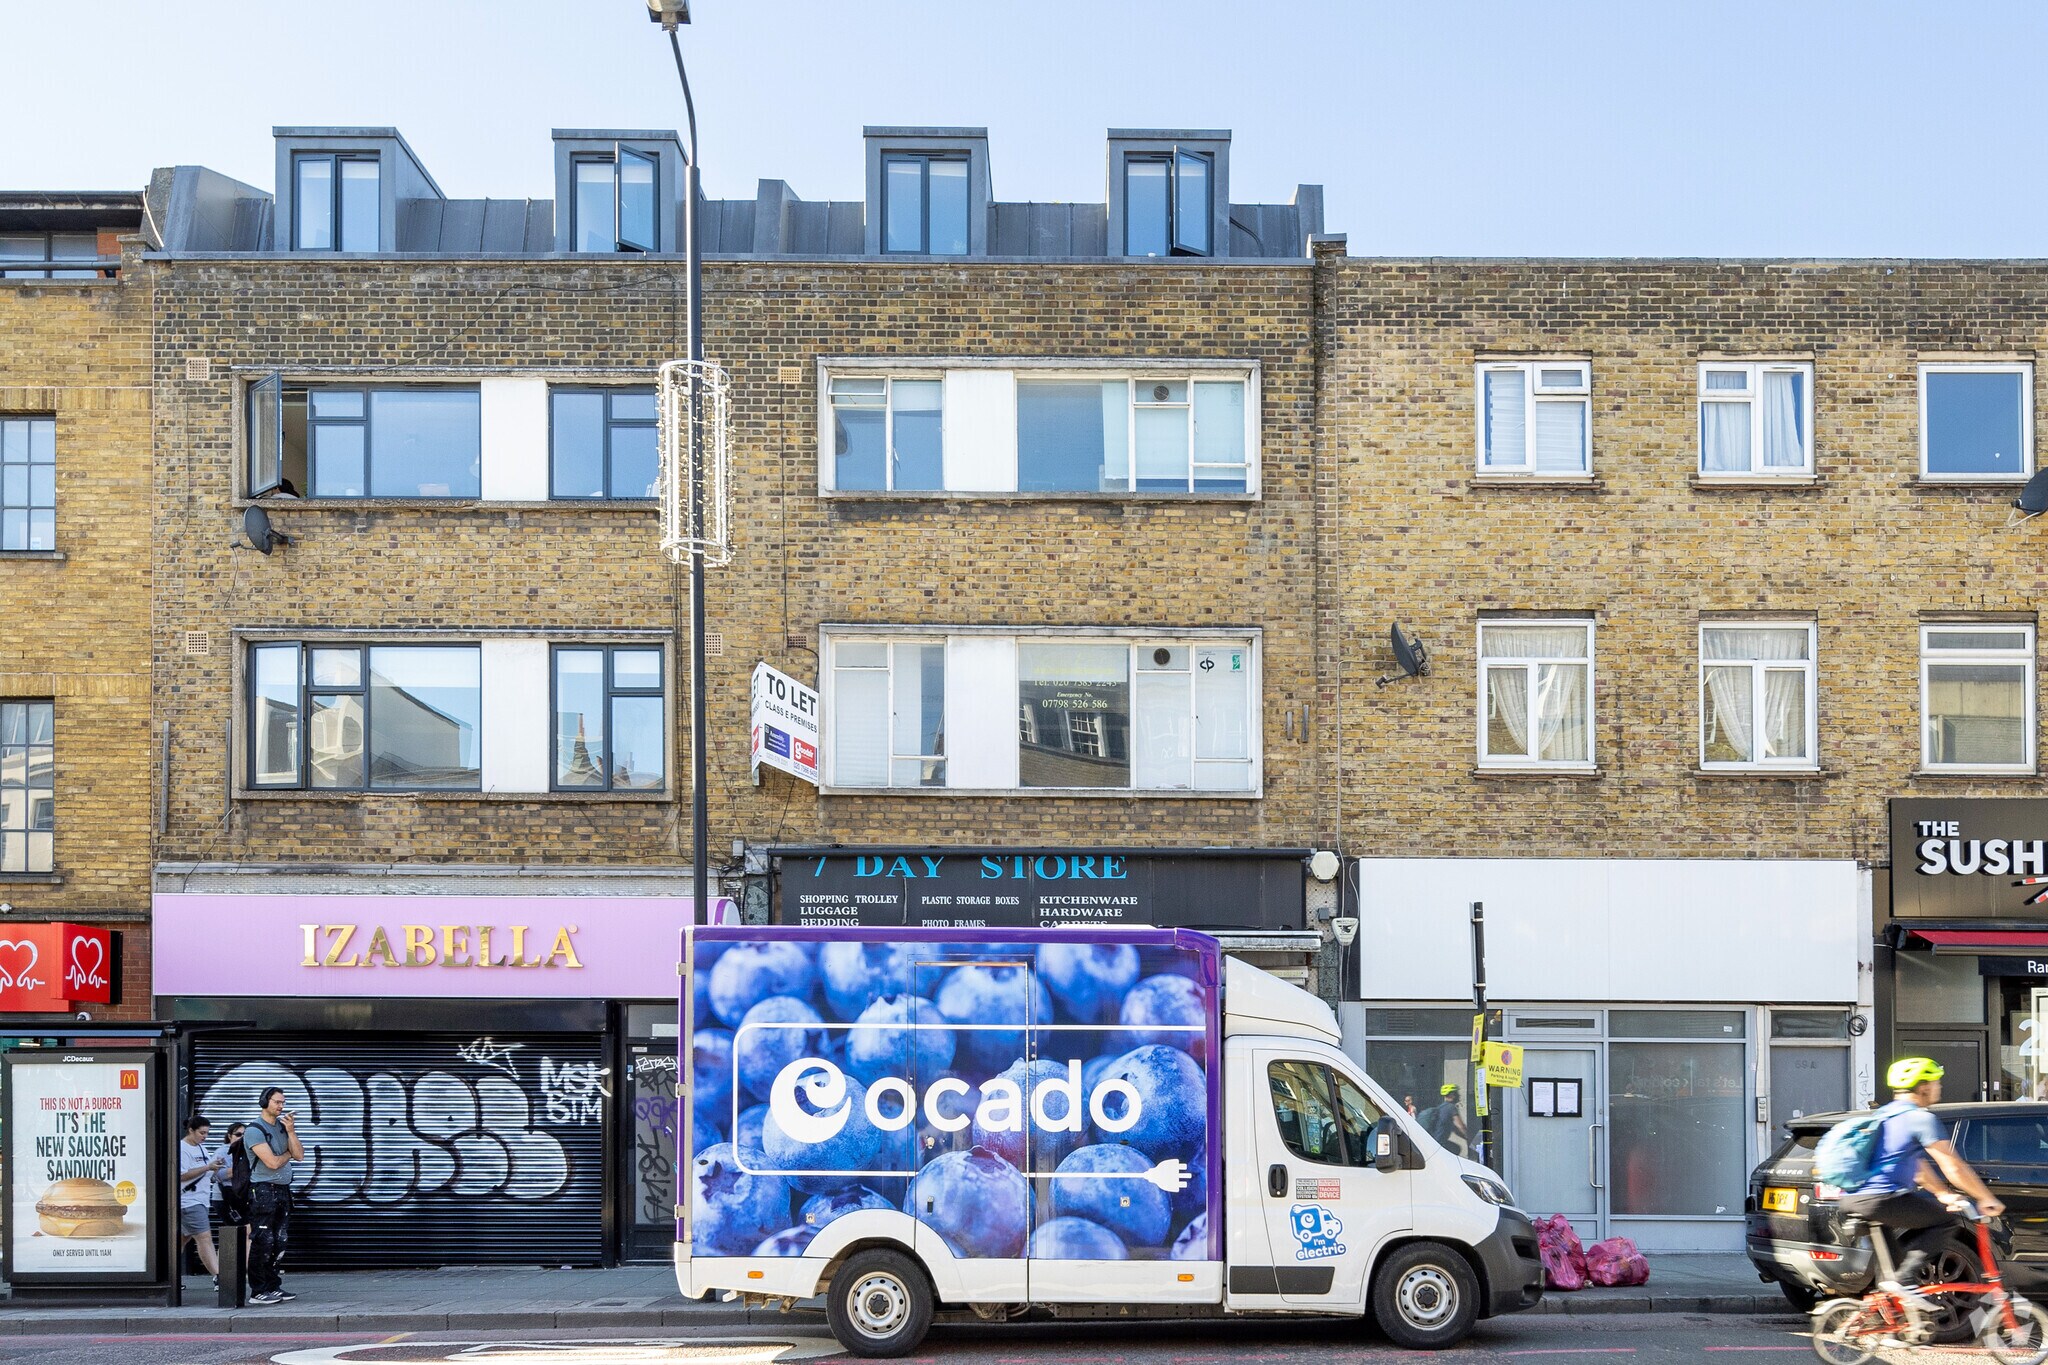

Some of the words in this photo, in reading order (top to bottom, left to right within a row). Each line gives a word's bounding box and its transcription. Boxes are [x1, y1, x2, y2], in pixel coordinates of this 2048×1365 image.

[766, 672, 786, 701] TO
[791, 685, 816, 717] LET
[1042, 699, 1069, 708] 07798
[1072, 699, 1088, 708] 526
[1092, 699, 1108, 708] 586
[764, 699, 784, 717] CLASS
[790, 712, 818, 734] PREMISES
[1919, 821, 1960, 837] THE
[853, 856, 945, 878] DAY
[980, 855, 1128, 880] STORE
[800, 894, 849, 904] SHOPPING
[855, 894, 899, 904] TROLLEY
[921, 896, 952, 905] PLASTIC
[956, 896, 991, 905] STORAGE
[995, 896, 1020, 905] BOXES
[1039, 896, 1138, 905] KITCHENWARE
[800, 906, 858, 915] LUGGAGE
[1039, 908, 1123, 917] HARDWARE
[800, 918, 860, 927] BEDDING
[921, 919, 950, 928] PHOTO
[954, 919, 986, 928] FRAMES
[2027, 960, 2048, 974] Ra
[1488, 1064, 1521, 1077] WARNING
[863, 1059, 1143, 1133] ocado
[40, 1097, 57, 1110] THIS
[59, 1097, 66, 1110] IS
[68, 1097, 83, 1110] NOT
[84, 1097, 90, 1110] A
[92, 1097, 122, 1110] BURGER
[56, 1112, 79, 1134] IT'S
[82, 1112, 106, 1133] THE
[36, 1136, 64, 1157] NEW
[68, 1136, 126, 1157] SAUSAGE
[47, 1159, 116, 1181] SANDWICH
[116, 1187, 136, 1199] £1.99
[1319, 1191, 1340, 1199] DEVICE
[1313, 1238, 1325, 1247] I'm
[52, 1248, 66, 1257] ONLY
[66, 1248, 84, 1257] SERVED
[85, 1248, 99, 1257] UNTIL
[99, 1248, 112, 1257] 11AM
[1297, 1243, 1345, 1260] electric
